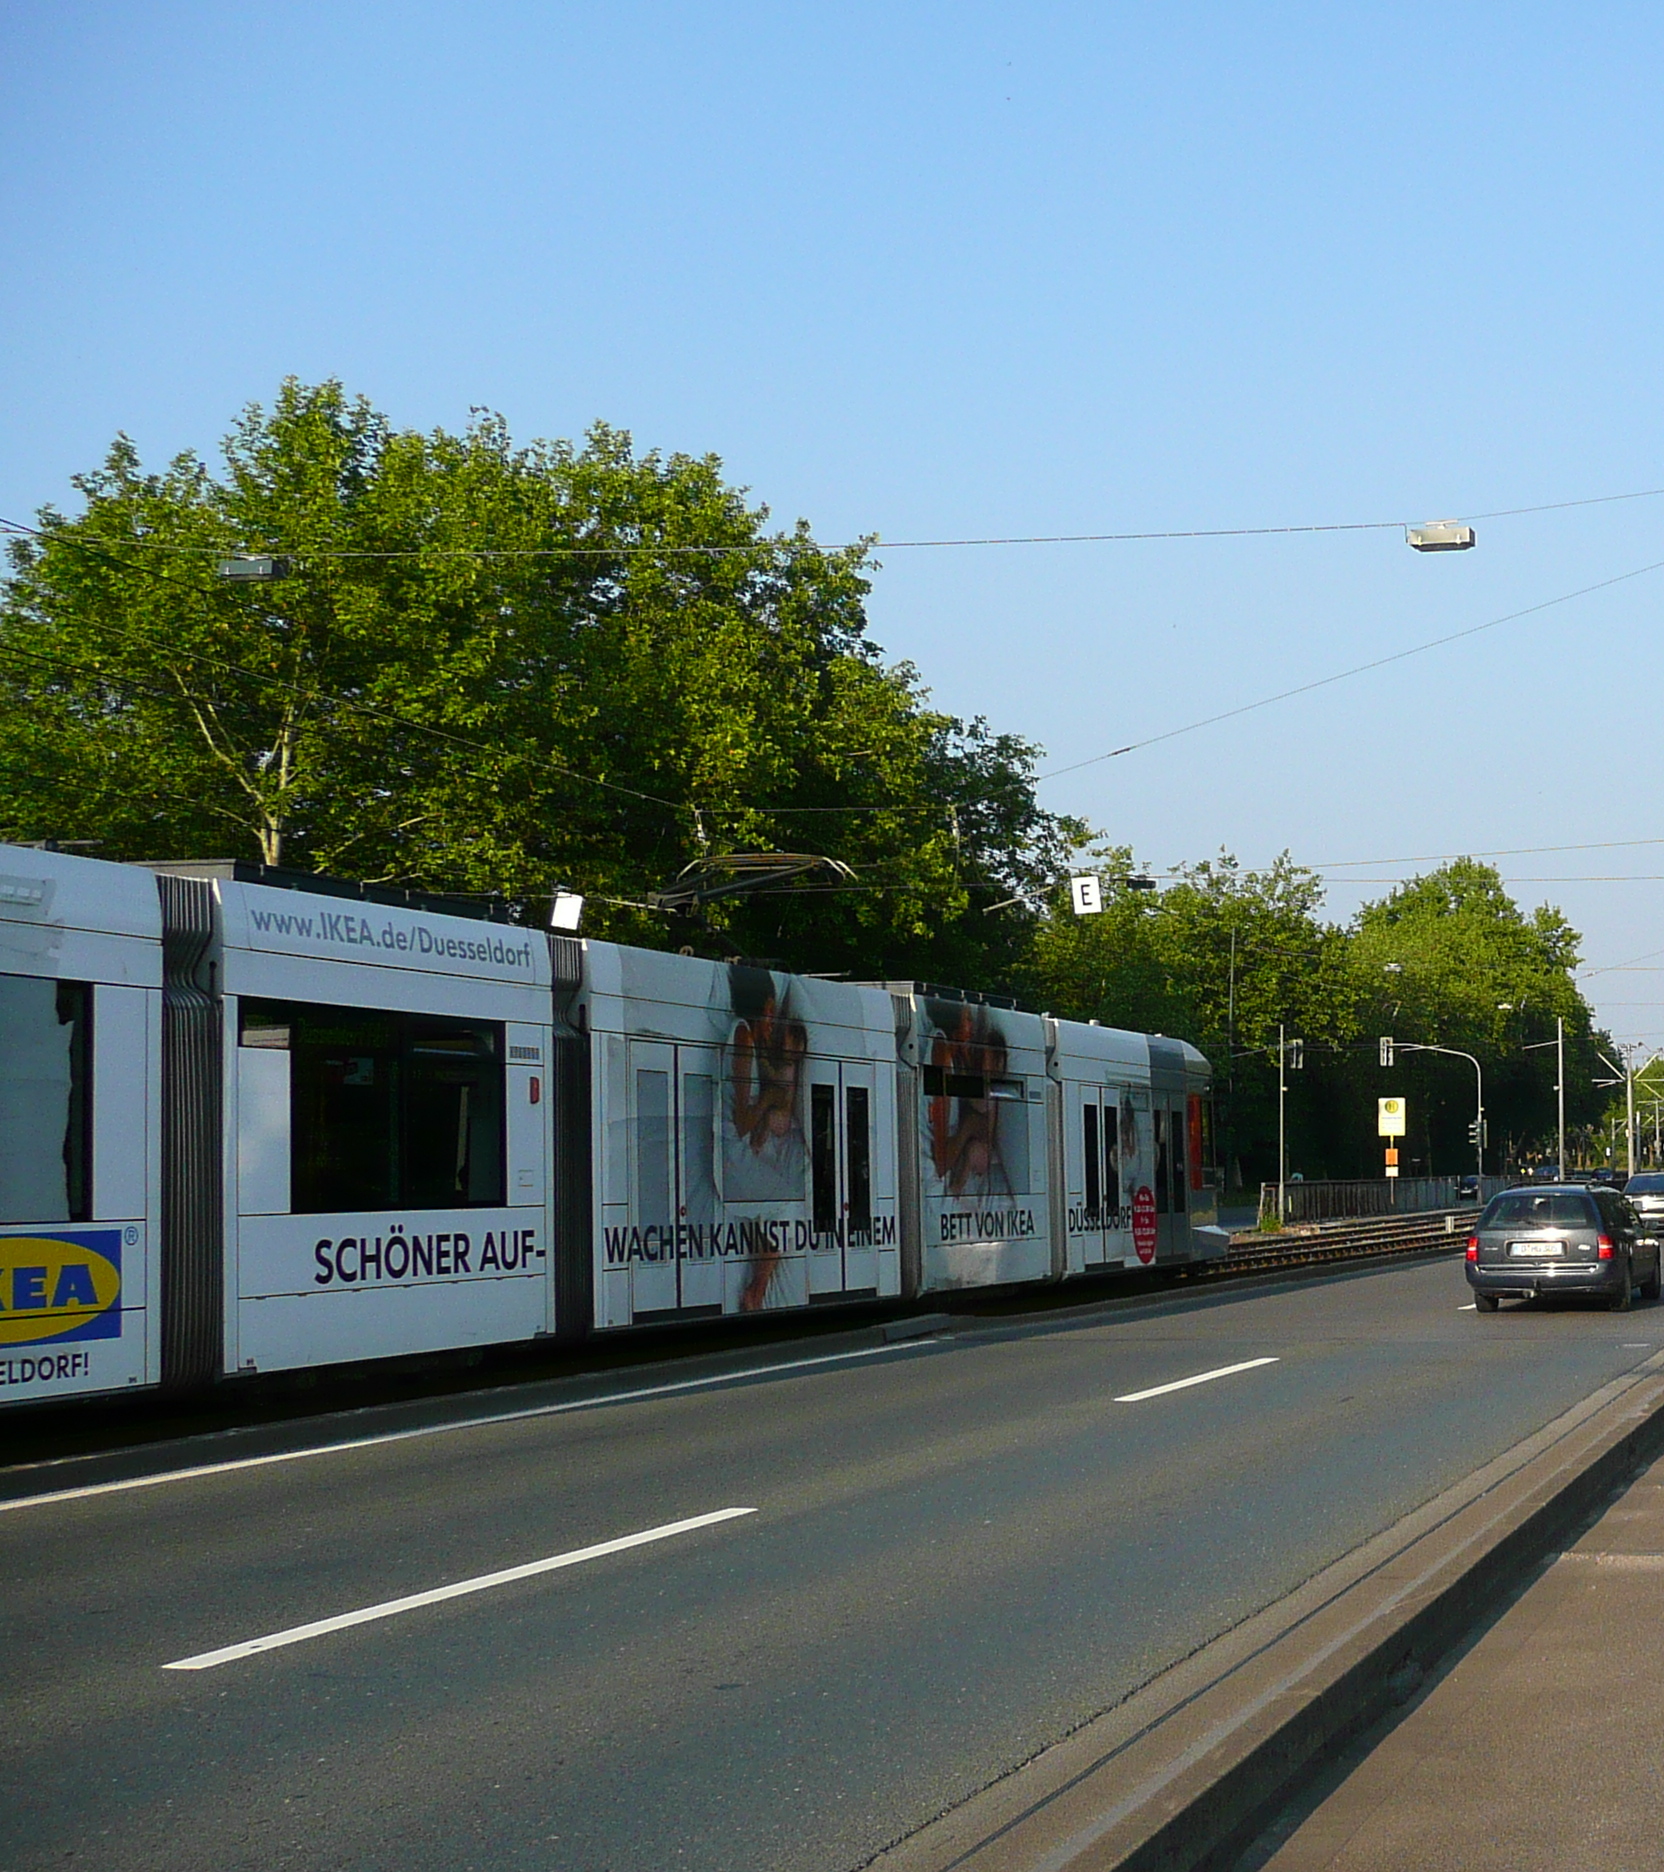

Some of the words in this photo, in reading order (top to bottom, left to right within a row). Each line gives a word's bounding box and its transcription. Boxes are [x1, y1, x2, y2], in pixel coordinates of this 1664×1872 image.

[1080, 884, 1093, 906] E
[251, 909, 531, 968] www.IKEA.de/Duesseldorf
[604, 1224, 701, 1263] WACHEN
[710, 1220, 790, 1256] KANNST
[795, 1220, 819, 1251] DU
[824, 1217, 843, 1249] IN
[847, 1215, 896, 1248] EINEM
[940, 1212, 972, 1241] BETT
[975, 1210, 1005, 1238] VON
[1007, 1209, 1036, 1237] IKEA
[1068, 1202, 1132, 1232] DÜSSELDORF
[314, 1224, 471, 1284] SCHÖNER
[479, 1229, 546, 1272] AUF-
[0, 1264, 100, 1311] EA
